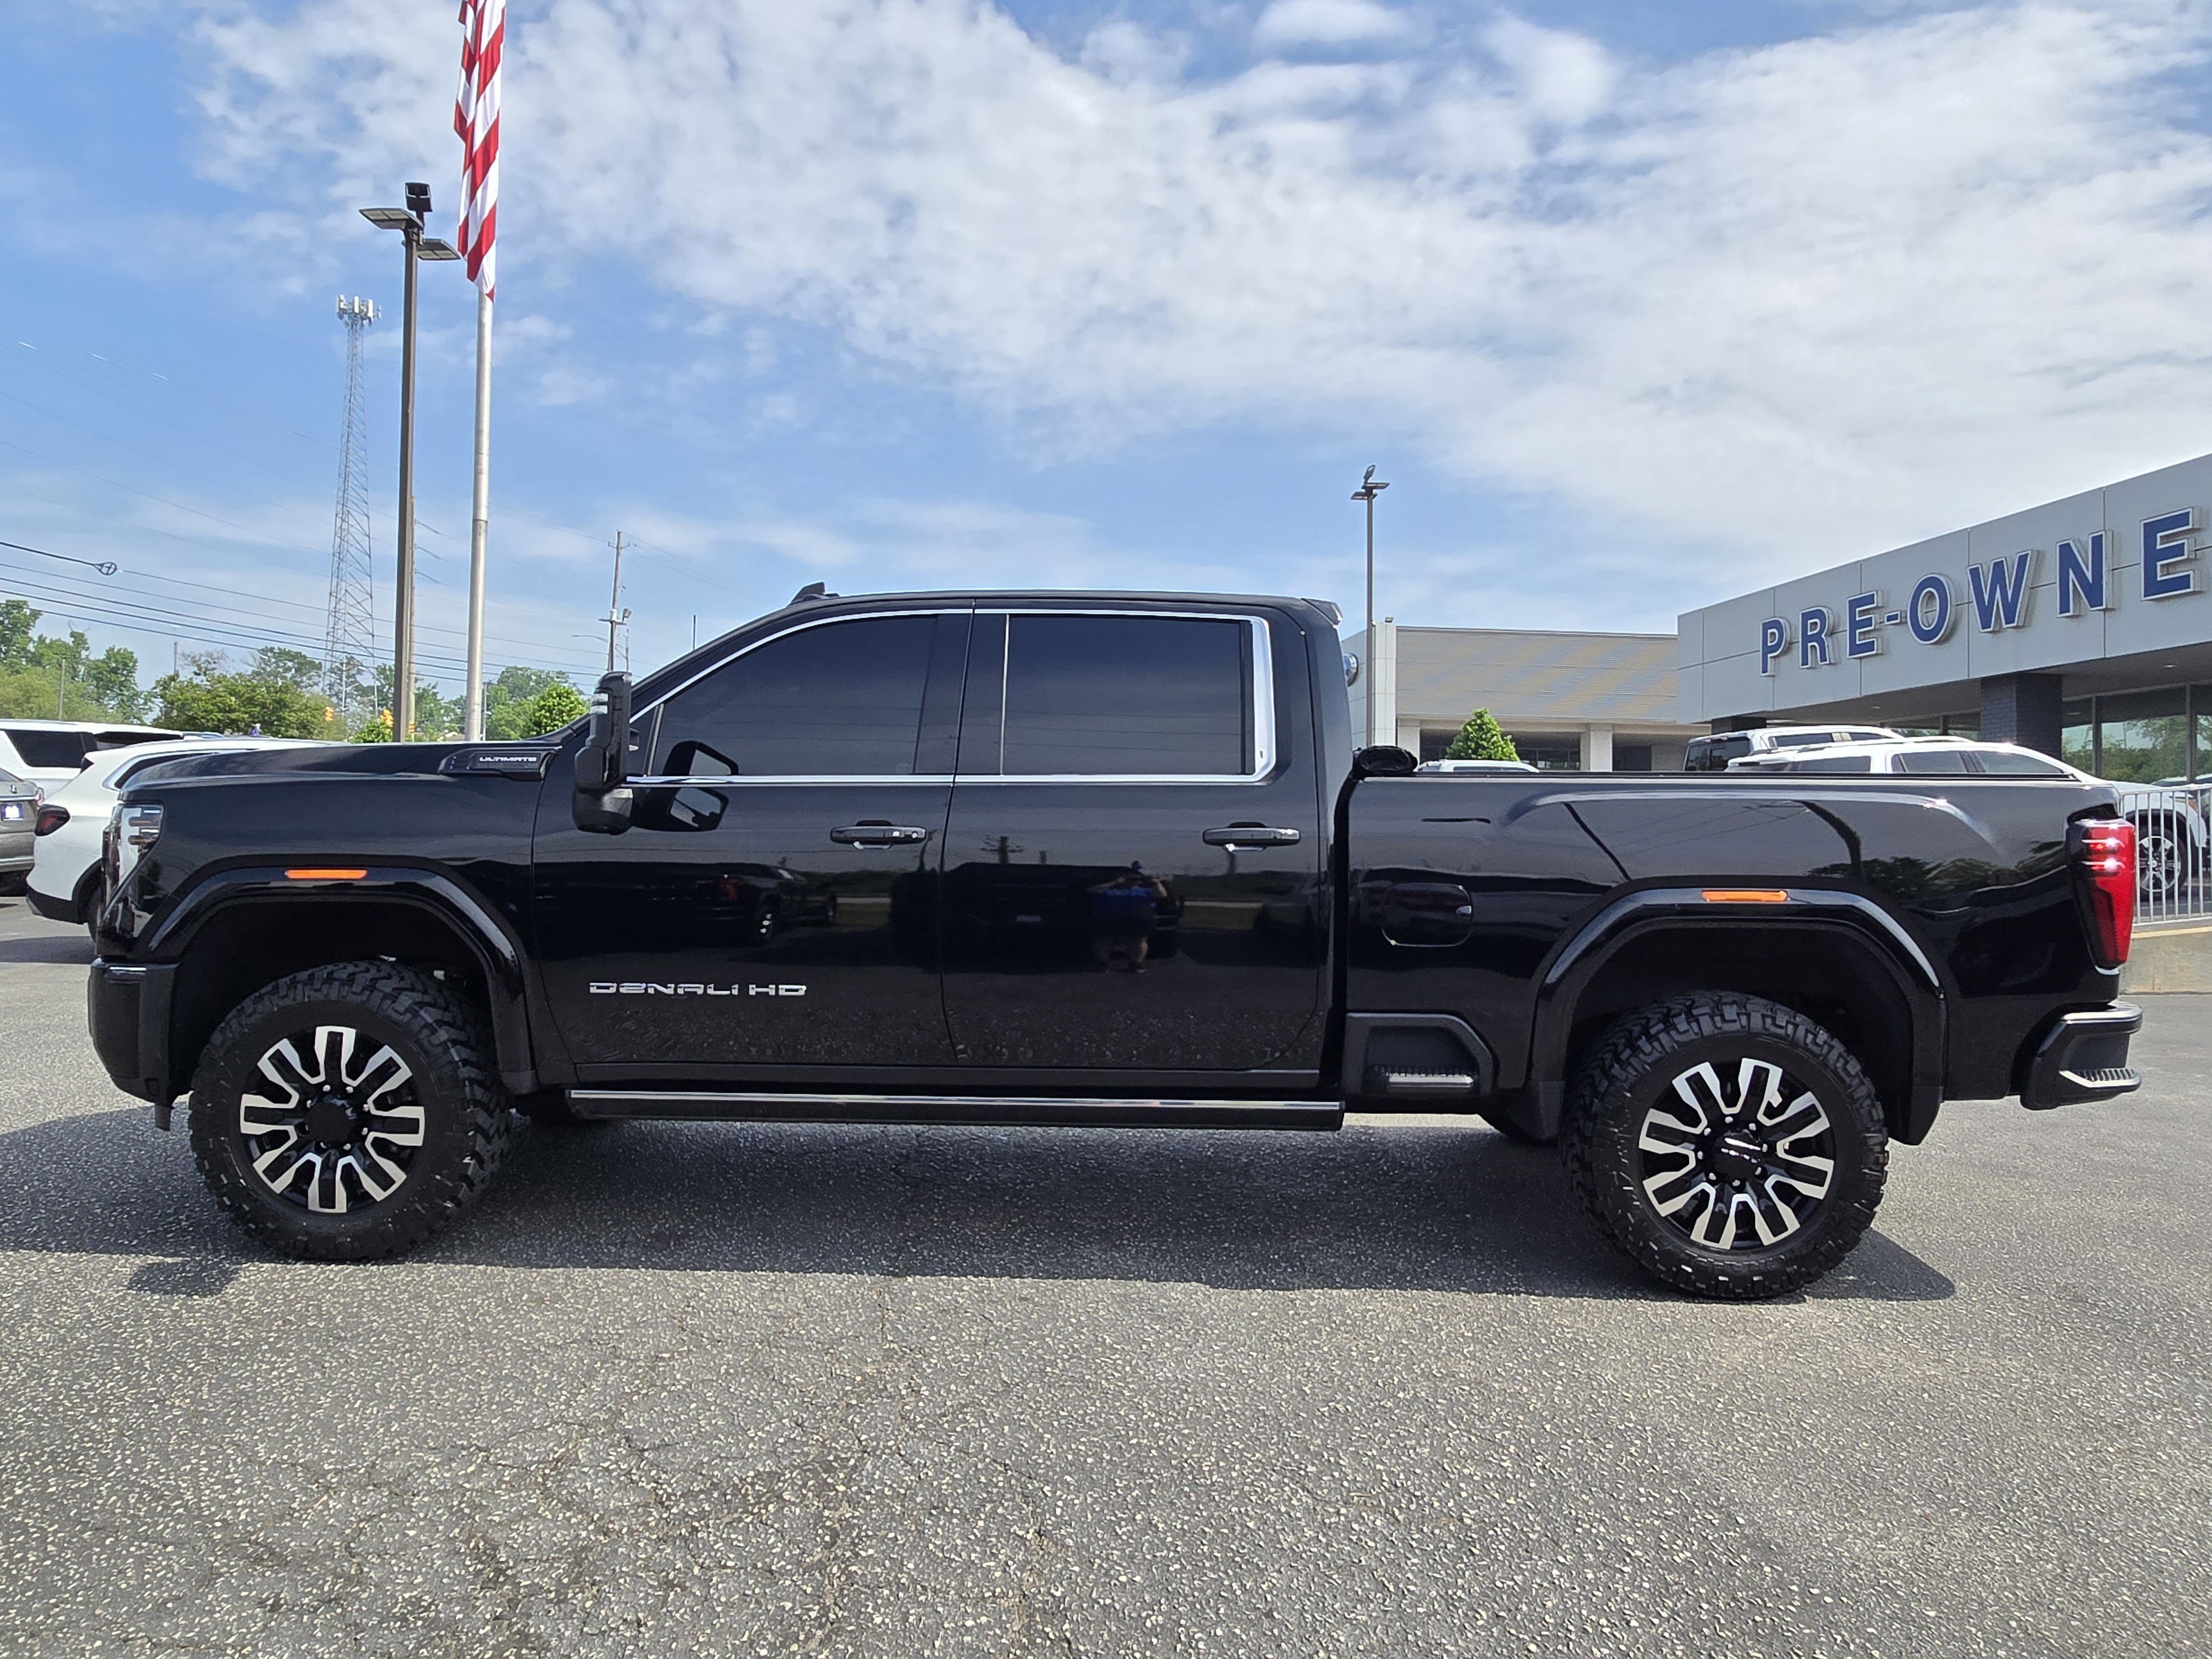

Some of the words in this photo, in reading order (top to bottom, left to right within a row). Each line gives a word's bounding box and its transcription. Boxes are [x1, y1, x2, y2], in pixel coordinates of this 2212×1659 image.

[1760, 507, 2201, 676] PRE-OWNE
[589, 983, 738, 995] DENALI
[749, 984, 807, 995] HD
